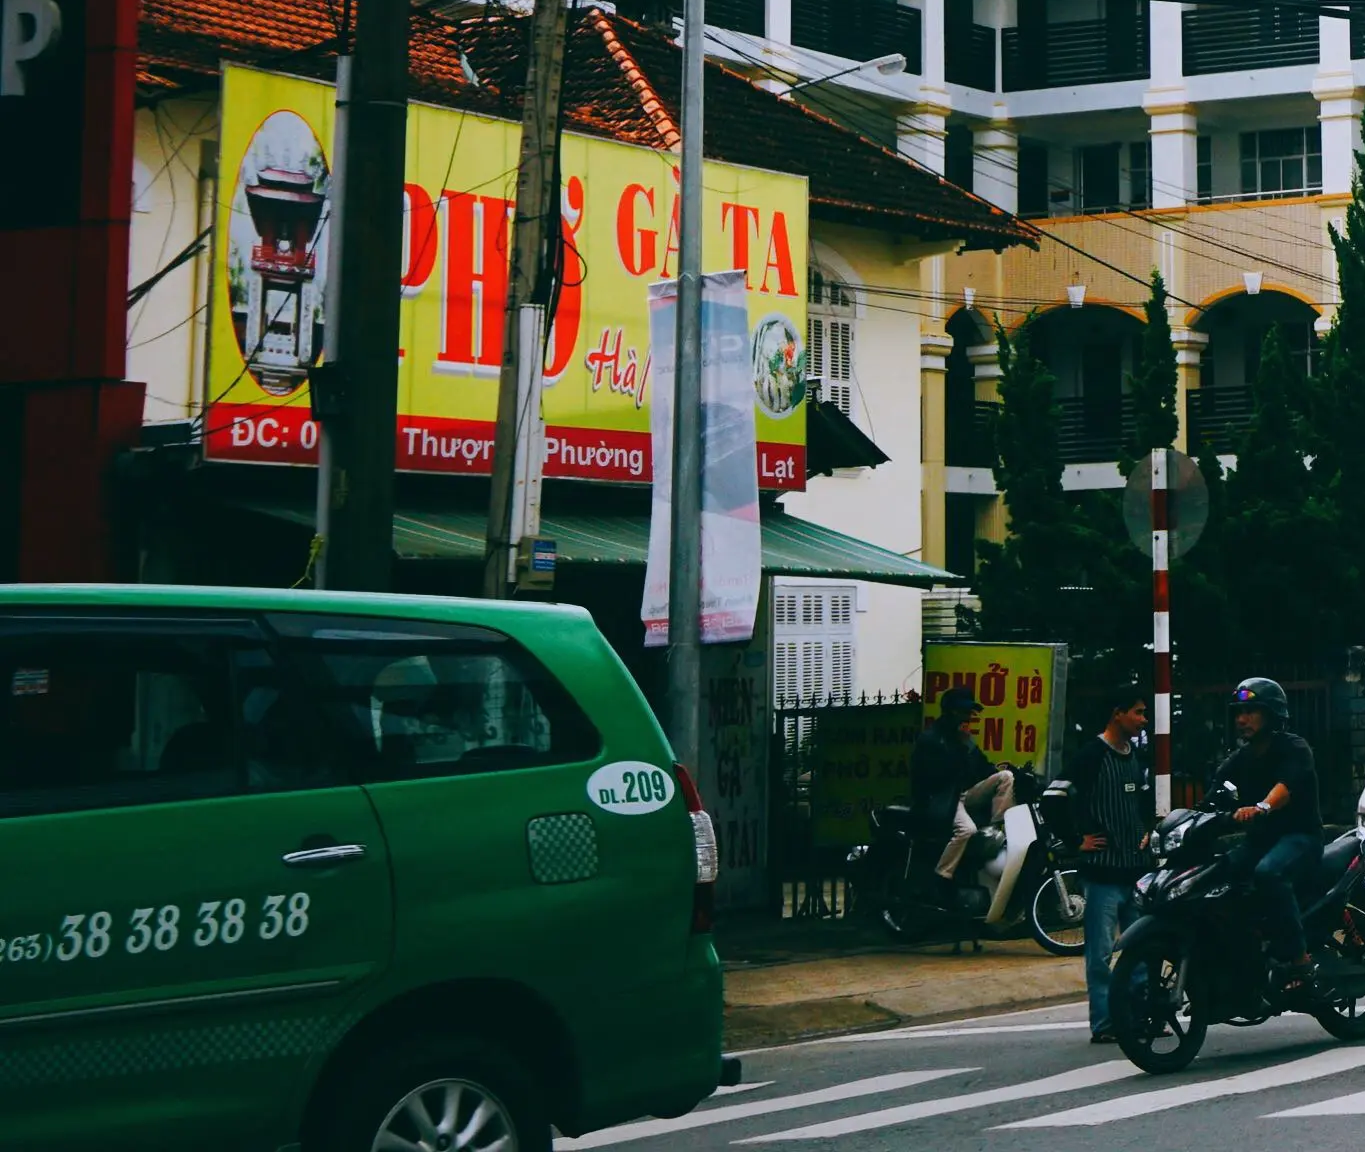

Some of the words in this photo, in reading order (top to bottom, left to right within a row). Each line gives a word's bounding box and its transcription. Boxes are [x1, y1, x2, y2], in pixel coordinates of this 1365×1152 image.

[722, 203, 798, 296] TA
[231, 417, 289, 447] ĐC:
[542, 436, 643, 474] Phường
[762, 453, 795, 480] Lạt
[925, 663, 1007, 707] PHỞ
[1017, 669, 1043, 710] gà
[1015, 719, 1037, 753] ta
[599, 770, 666, 804] DL.209
[57, 911, 112, 961] 38
[126, 904, 180, 954] 38
[194, 898, 245, 947] 38
[259, 892, 310, 940] 38
